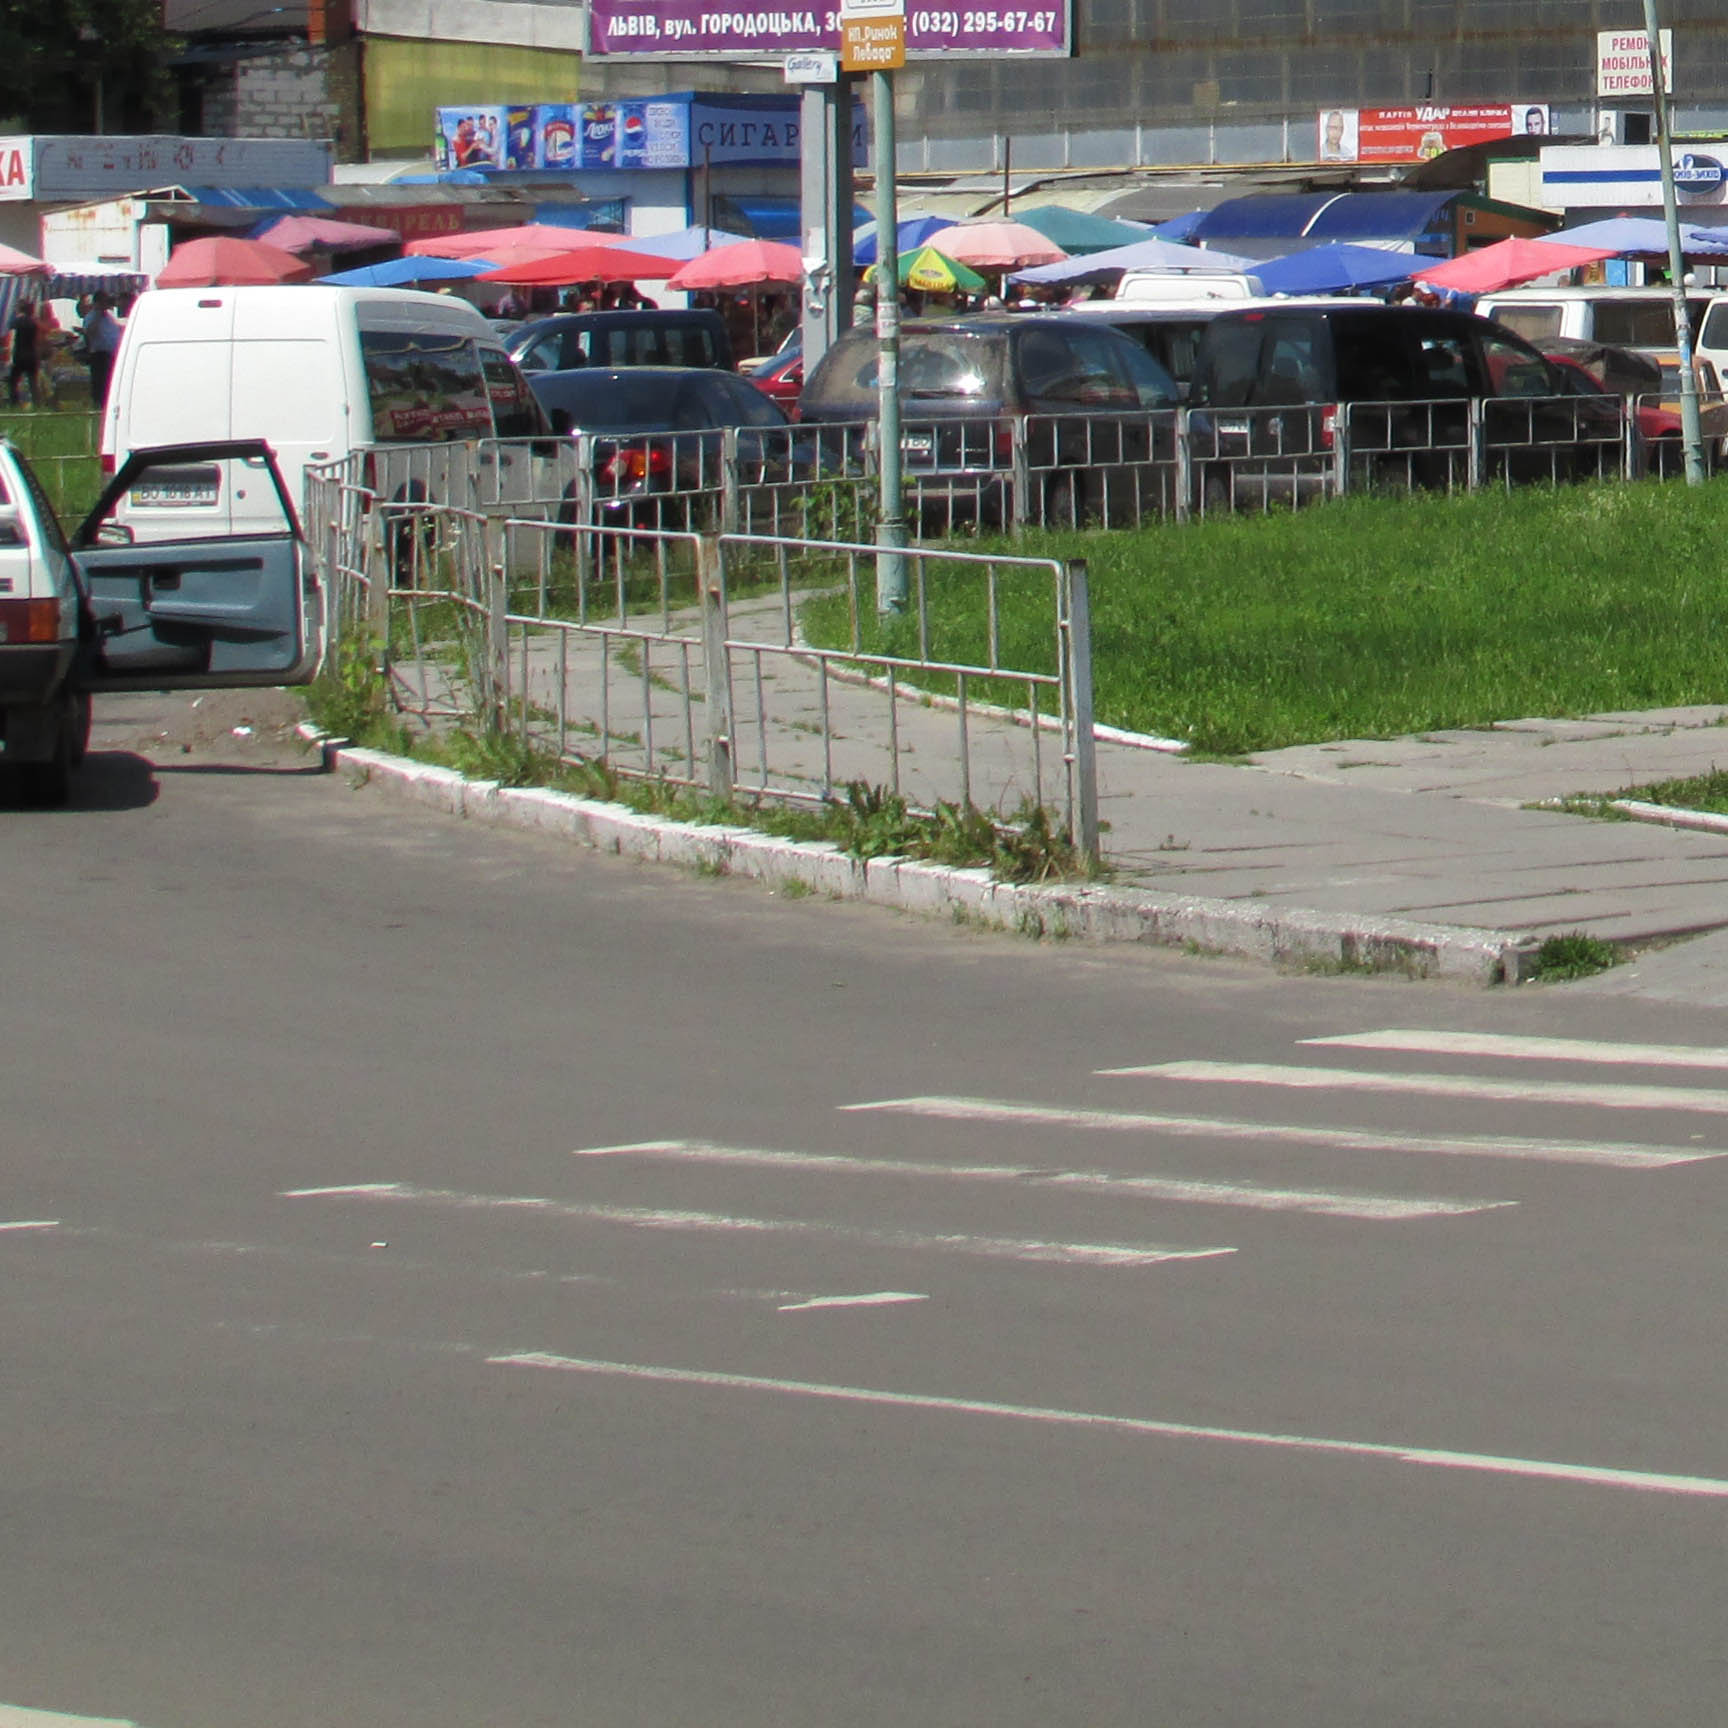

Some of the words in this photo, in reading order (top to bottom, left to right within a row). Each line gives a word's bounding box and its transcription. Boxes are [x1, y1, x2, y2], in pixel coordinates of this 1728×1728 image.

[608, 16, 660, 39] ЛЬВІВ,
[664, 19, 697, 39] вул.
[701, 11, 821, 37] ГОРОДОЦЬКА,
[912, 11, 959, 37] (032)
[963, 11, 1056, 33] 295-67-67
[1612, 36, 1649, 51] РЕМОН
[1602, 55, 1667, 70] МОБІЛЬНХ
[1415, 106, 1450, 121] УДАР
[699, 123, 862, 147] СИГАРИ
[347, 212, 461, 232] КВАРЕЛЬ
